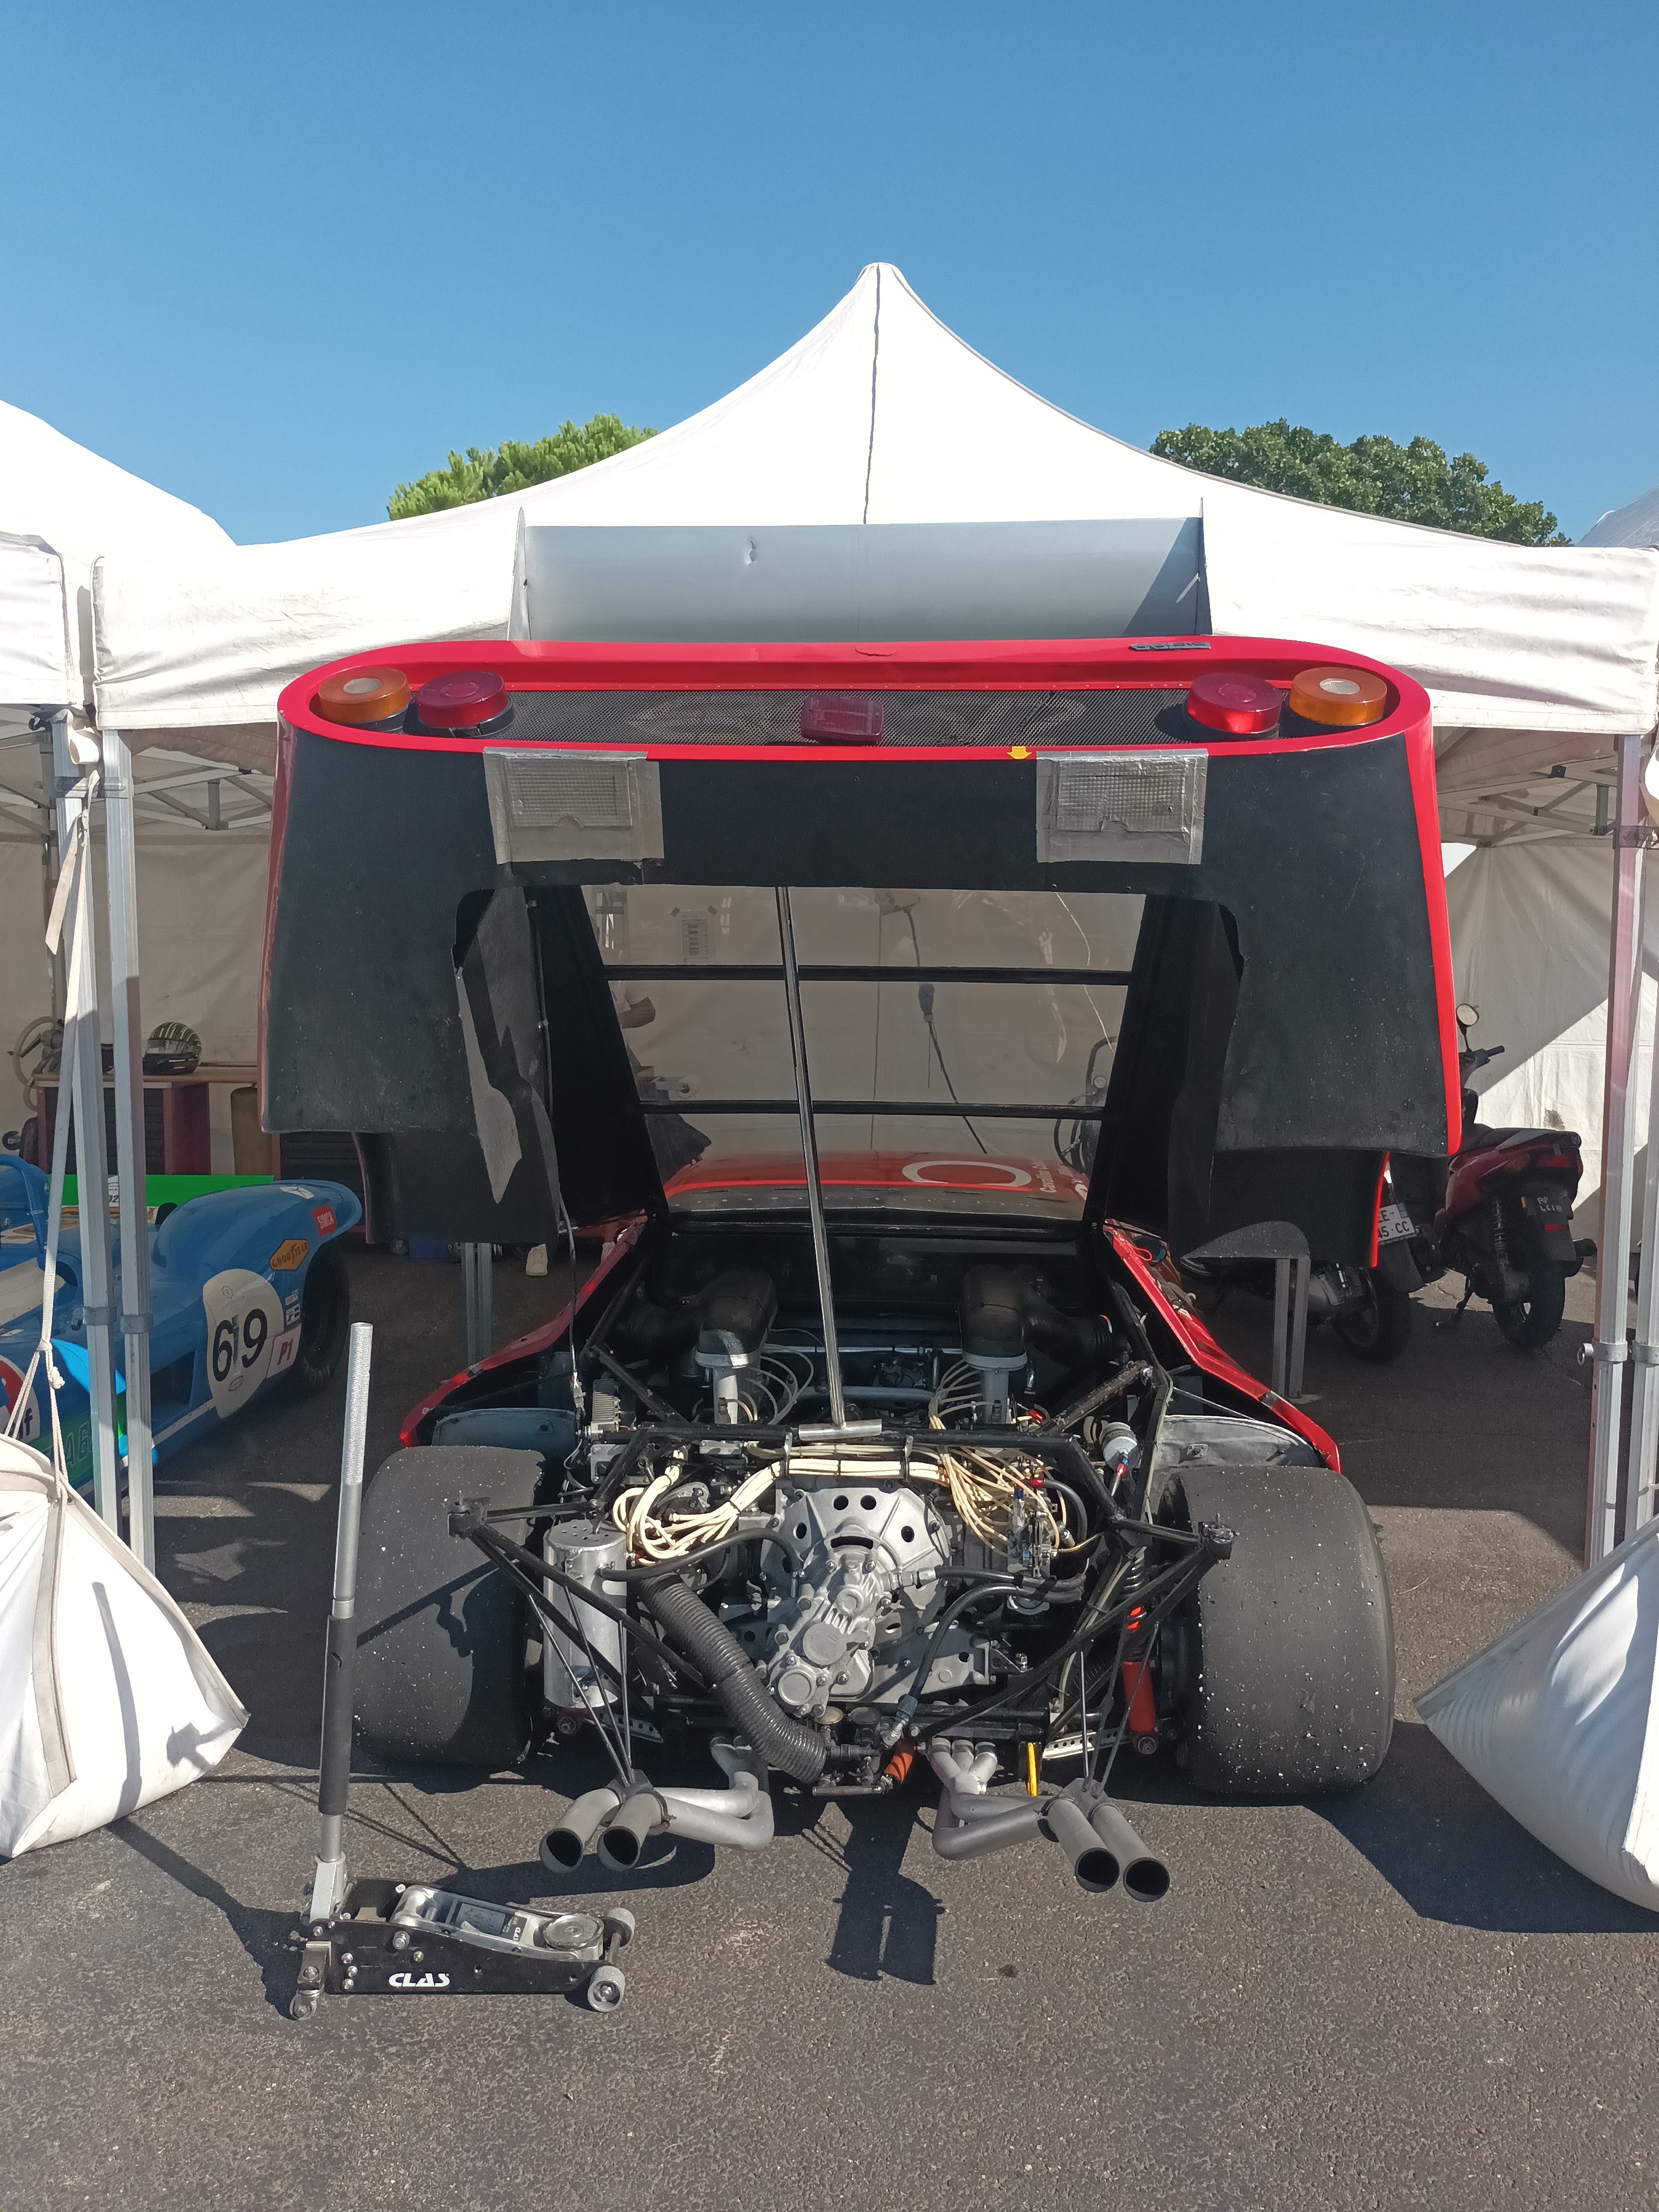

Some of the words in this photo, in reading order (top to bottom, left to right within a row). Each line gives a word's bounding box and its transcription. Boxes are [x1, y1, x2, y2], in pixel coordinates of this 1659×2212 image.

[272, 1241, 308, 1268] GOODYEAR
[212, 1308, 268, 1382] 69
[277, 1338, 294, 1366] P1
[388, 1973, 450, 1987] CLAS
